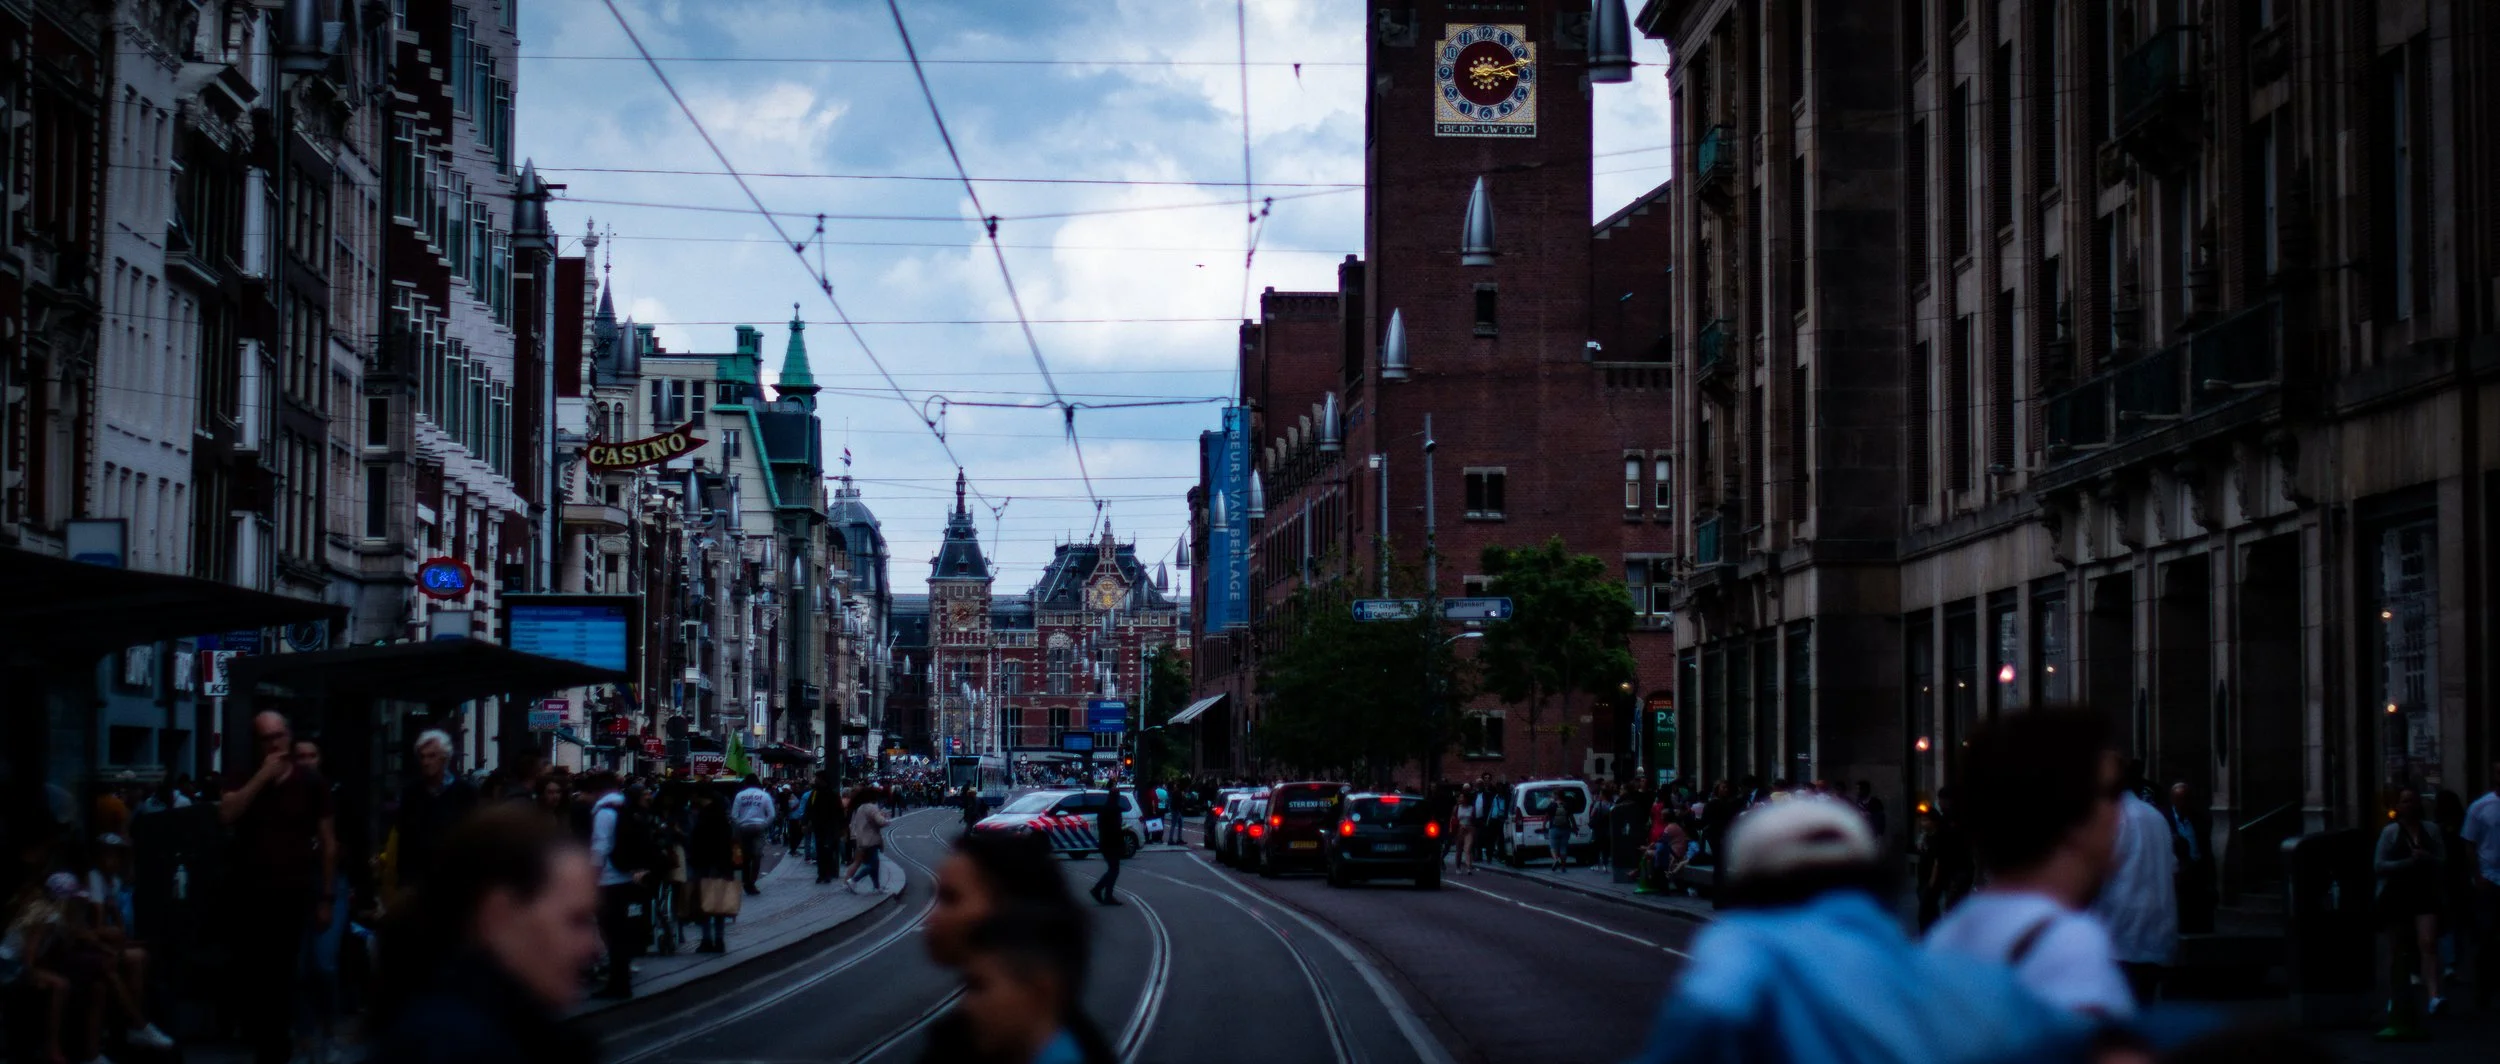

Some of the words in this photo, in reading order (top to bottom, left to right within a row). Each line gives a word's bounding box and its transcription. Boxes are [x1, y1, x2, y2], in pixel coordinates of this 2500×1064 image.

[1462, 31, 1469, 43] 11
[1480, 28, 1492, 39] 12
[1445, 48, 1456, 58] 10
[1517, 48, 1525, 58] 2
[1442, 67, 1450, 79] 9
[1522, 68, 1530, 80] 3
[1447, 87, 1455, 99] 8
[1517, 88, 1525, 100] 4
[1462, 102, 1469, 114] 7
[1482, 107, 1490, 119] 6
[1502, 103, 1510, 114] 5
[1481, 125, 1499, 133] UW
[1505, 125, 1528, 133] TYD
[588, 432, 687, 466] CASINO
[1230, 431, 1240, 483] BEURS
[1230, 488, 1240, 521] VAN
[1230, 530, 1240, 601] BERLAGE
[425, 567, 465, 589] C&A
[696, 755, 724, 763] HOTDO
